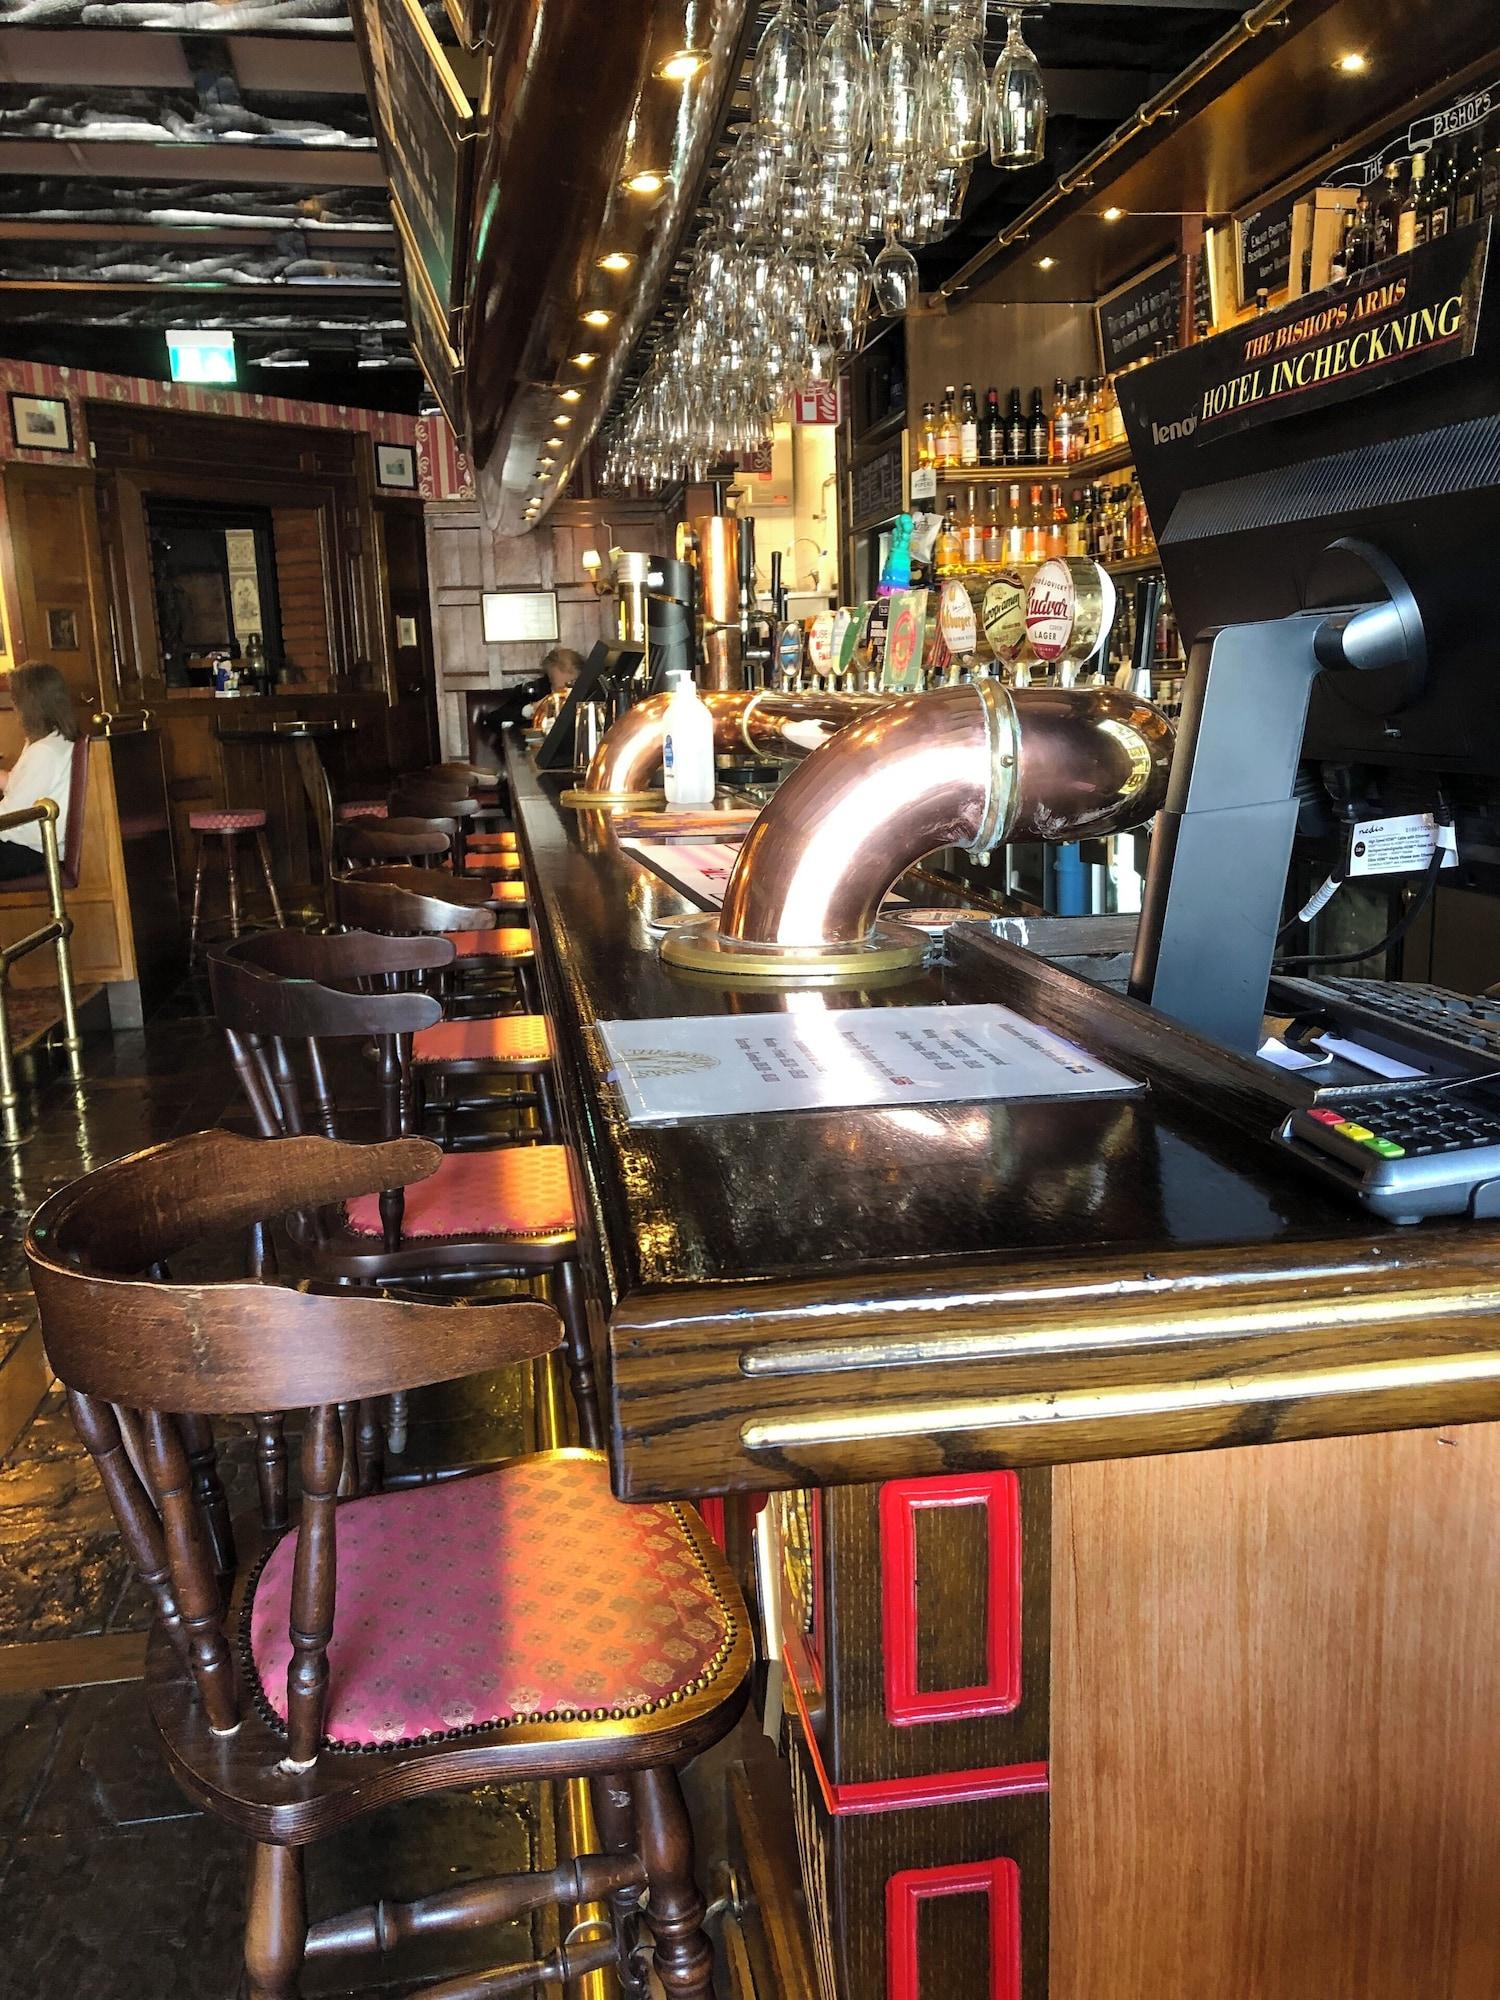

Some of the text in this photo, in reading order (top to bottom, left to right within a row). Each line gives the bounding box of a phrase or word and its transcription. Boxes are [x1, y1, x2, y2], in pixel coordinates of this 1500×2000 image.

[1362, 93, 1491, 183] THE BISHOPS
[1202, 370, 1264, 420] HOTEL
[1268, 295, 1464, 396] INCHECKNING
[1244, 277, 1407, 361] THE BISHOPS ARMS
[1034, 630, 1057, 640] LAGER
